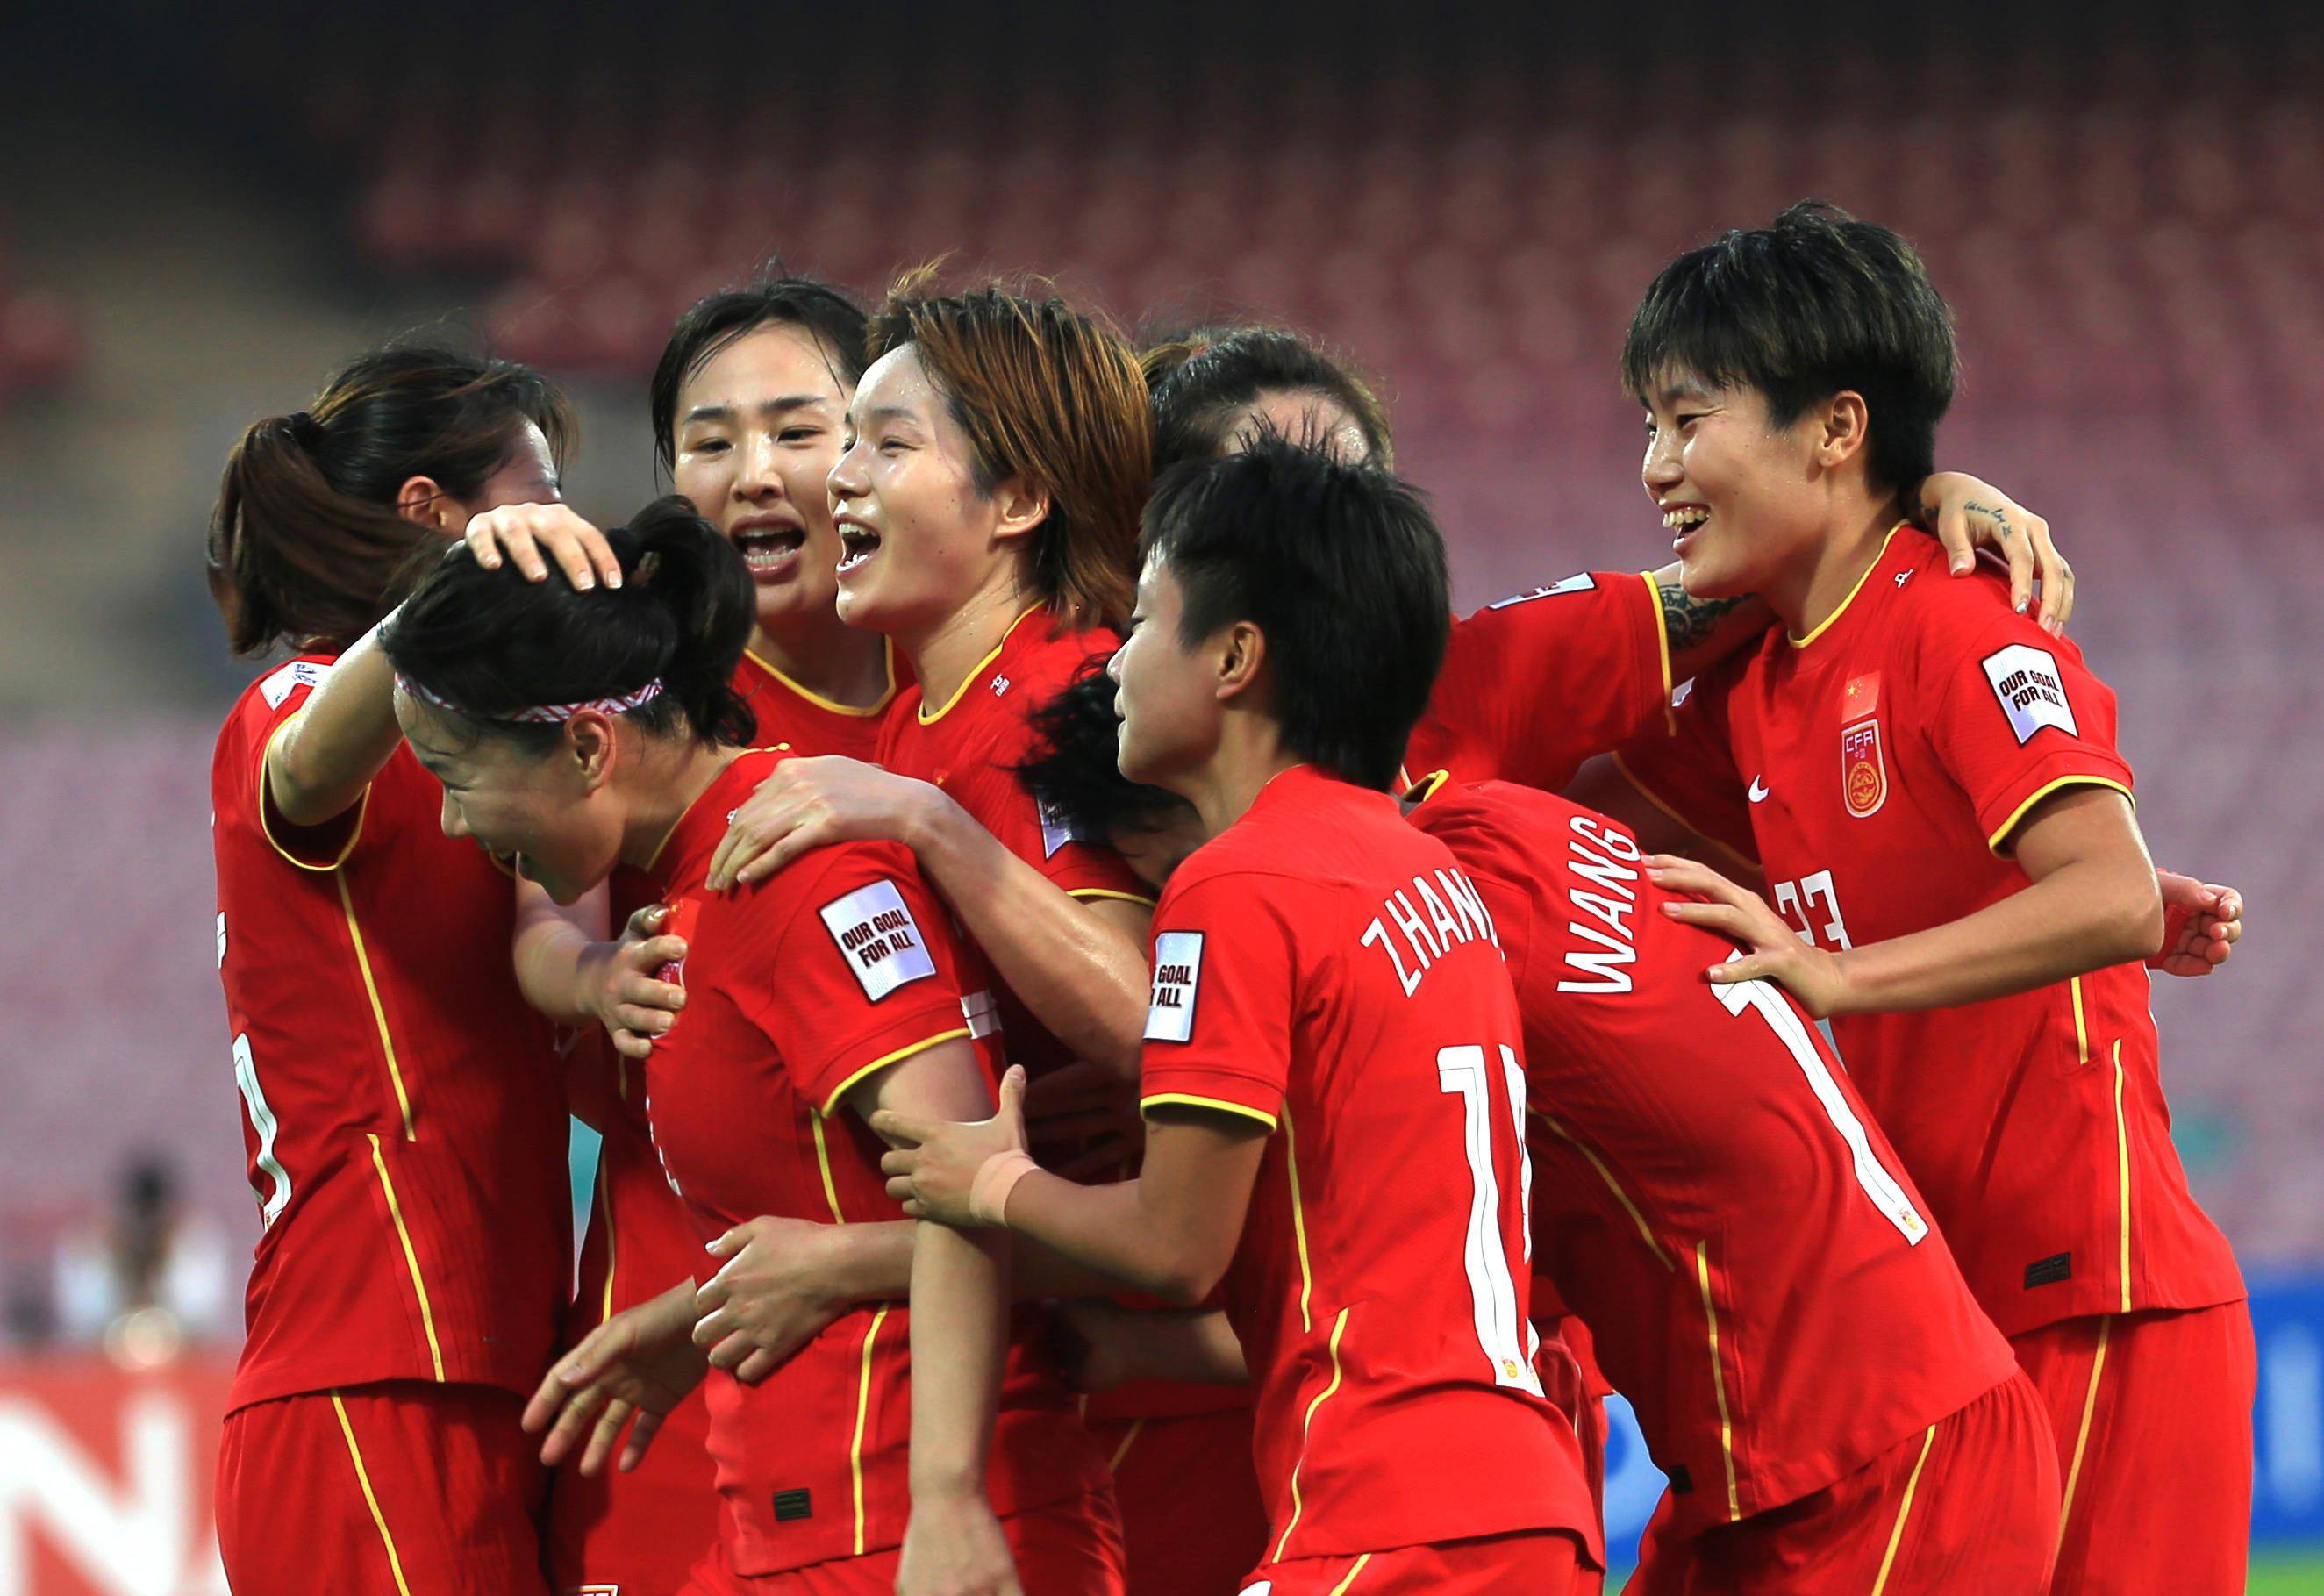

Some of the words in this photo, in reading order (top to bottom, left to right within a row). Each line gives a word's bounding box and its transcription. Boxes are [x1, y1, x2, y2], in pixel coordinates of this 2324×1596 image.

[1999, 670, 2028, 698] OUR
[2029, 670, 2060, 692] GOAL
[2012, 686, 2041, 712] FOR
[2042, 688, 2063, 708] ALL
[1845, 730, 1874, 753] CFA
[1556, 816, 1641, 993] WANG
[841, 922, 875, 950] OUR
[872, 908, 910, 933] GOAL
[858, 939, 890, 968] FOR
[889, 930, 915, 951] ALL
[1158, 964, 1191, 984] GOAL
[1157, 988, 1182, 1007] ALL
